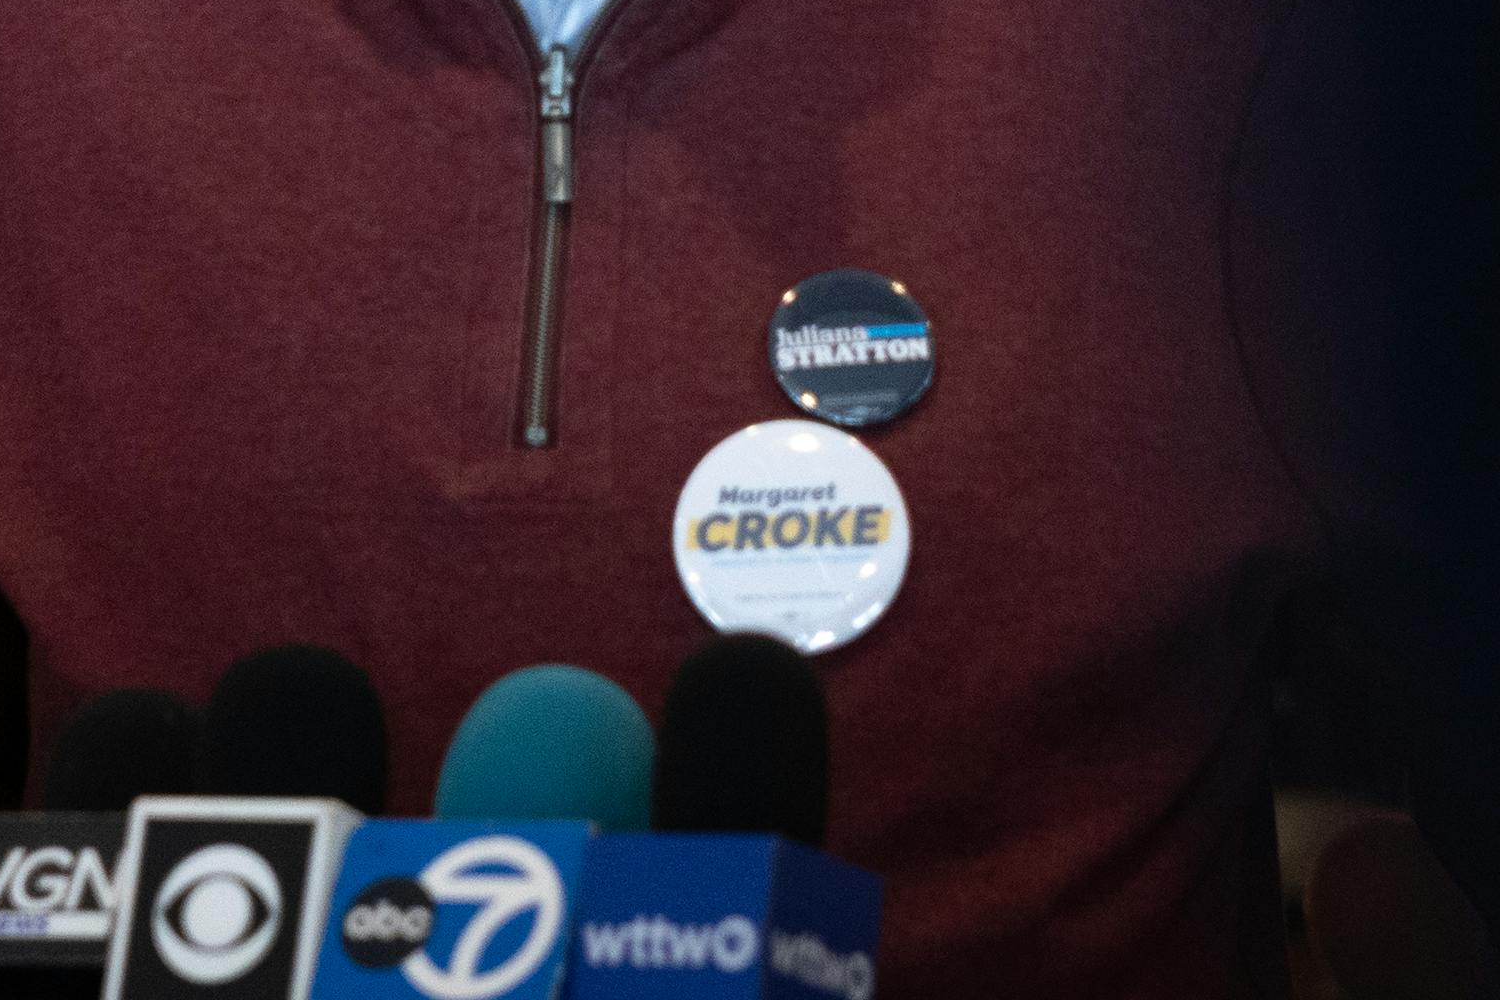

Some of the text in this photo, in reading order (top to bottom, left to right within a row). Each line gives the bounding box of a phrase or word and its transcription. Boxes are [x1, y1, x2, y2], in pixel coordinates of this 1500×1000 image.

[776, 338, 929, 370] STRATTON
[718, 481, 836, 508] Margaret
[696, 504, 884, 552] CROKE
[342, 834, 566, 1000] abc 7
